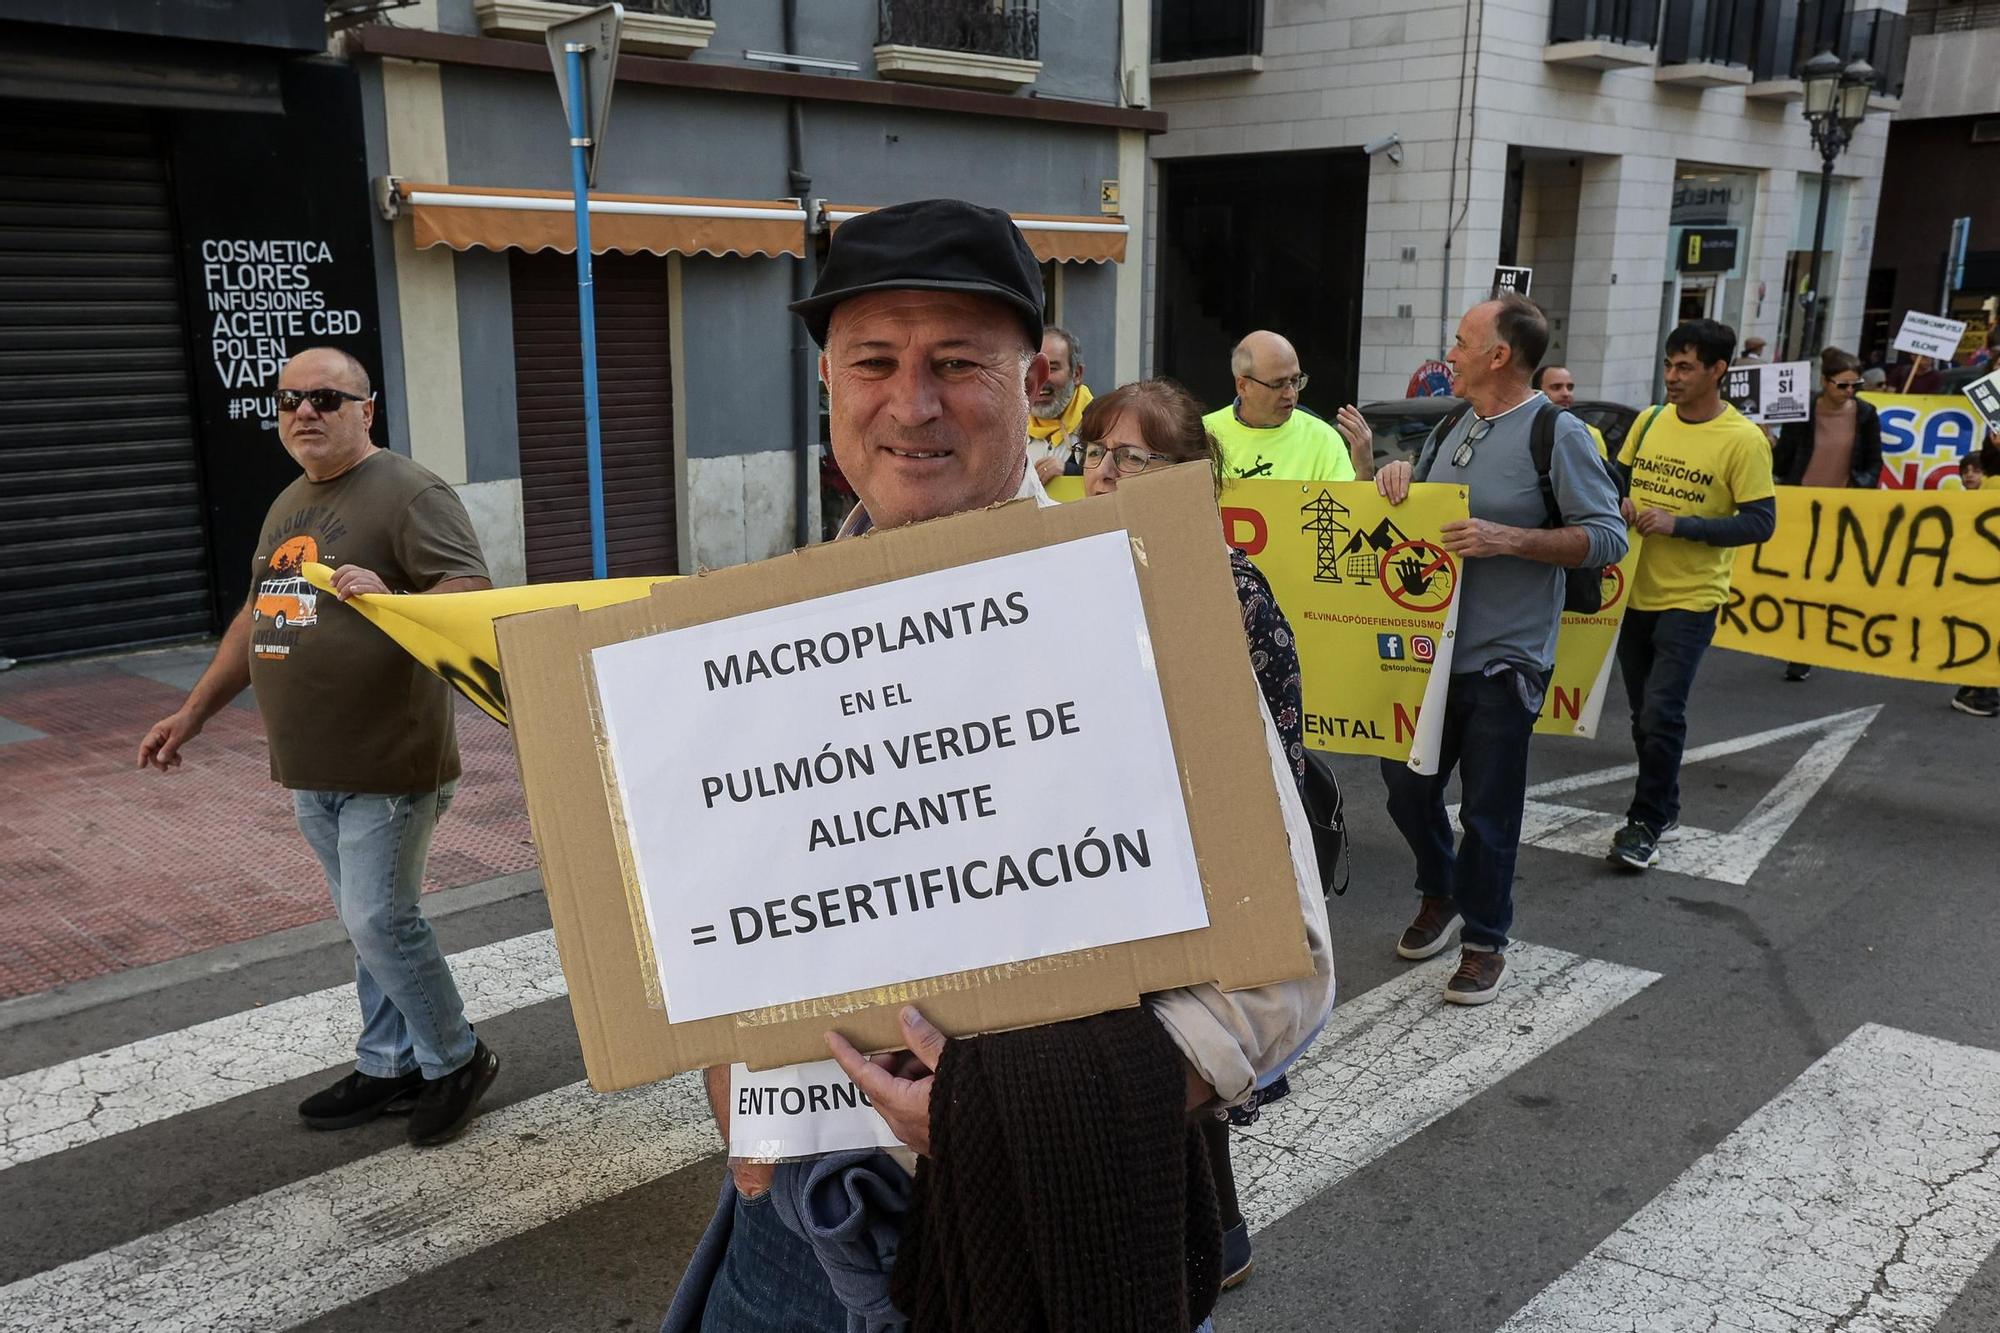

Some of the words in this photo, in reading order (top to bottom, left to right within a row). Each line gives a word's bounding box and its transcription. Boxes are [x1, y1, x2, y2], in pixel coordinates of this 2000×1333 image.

[202, 239, 333, 263] COSMETICA
[204, 264, 310, 290] FLORES
[1500, 271, 1517, 285] ASÍ
[207, 291, 325, 311] INFUSIONES
[212, 312, 304, 338] ACEITE
[310, 310, 362, 335] CBD
[212, 338, 286, 360] POLEN
[1729, 383, 1750, 398] NO
[1778, 379, 1793, 394] SÍ
[1633, 457, 1714, 487] TRANSICIÓN
[1561, 616, 1619, 627] SUSMONTES
[1721, 586, 2000, 670] ROTEGID
[703, 591, 1030, 692] MACROPLANTAS
[840, 690, 876, 717] EN
[882, 683, 913, 707] EL
[1553, 686, 1587, 720] N
[1304, 713, 1385, 740] ENTAL
[701, 743, 875, 809] PULMÓN
[884, 714, 1017, 769] VERDE
[1028, 701, 1081, 742] DE
[808, 784, 997, 852] ALICANTE
[690, 923, 718, 946] =
[730, 826, 1152, 946] DESERTIFICACIÓN
